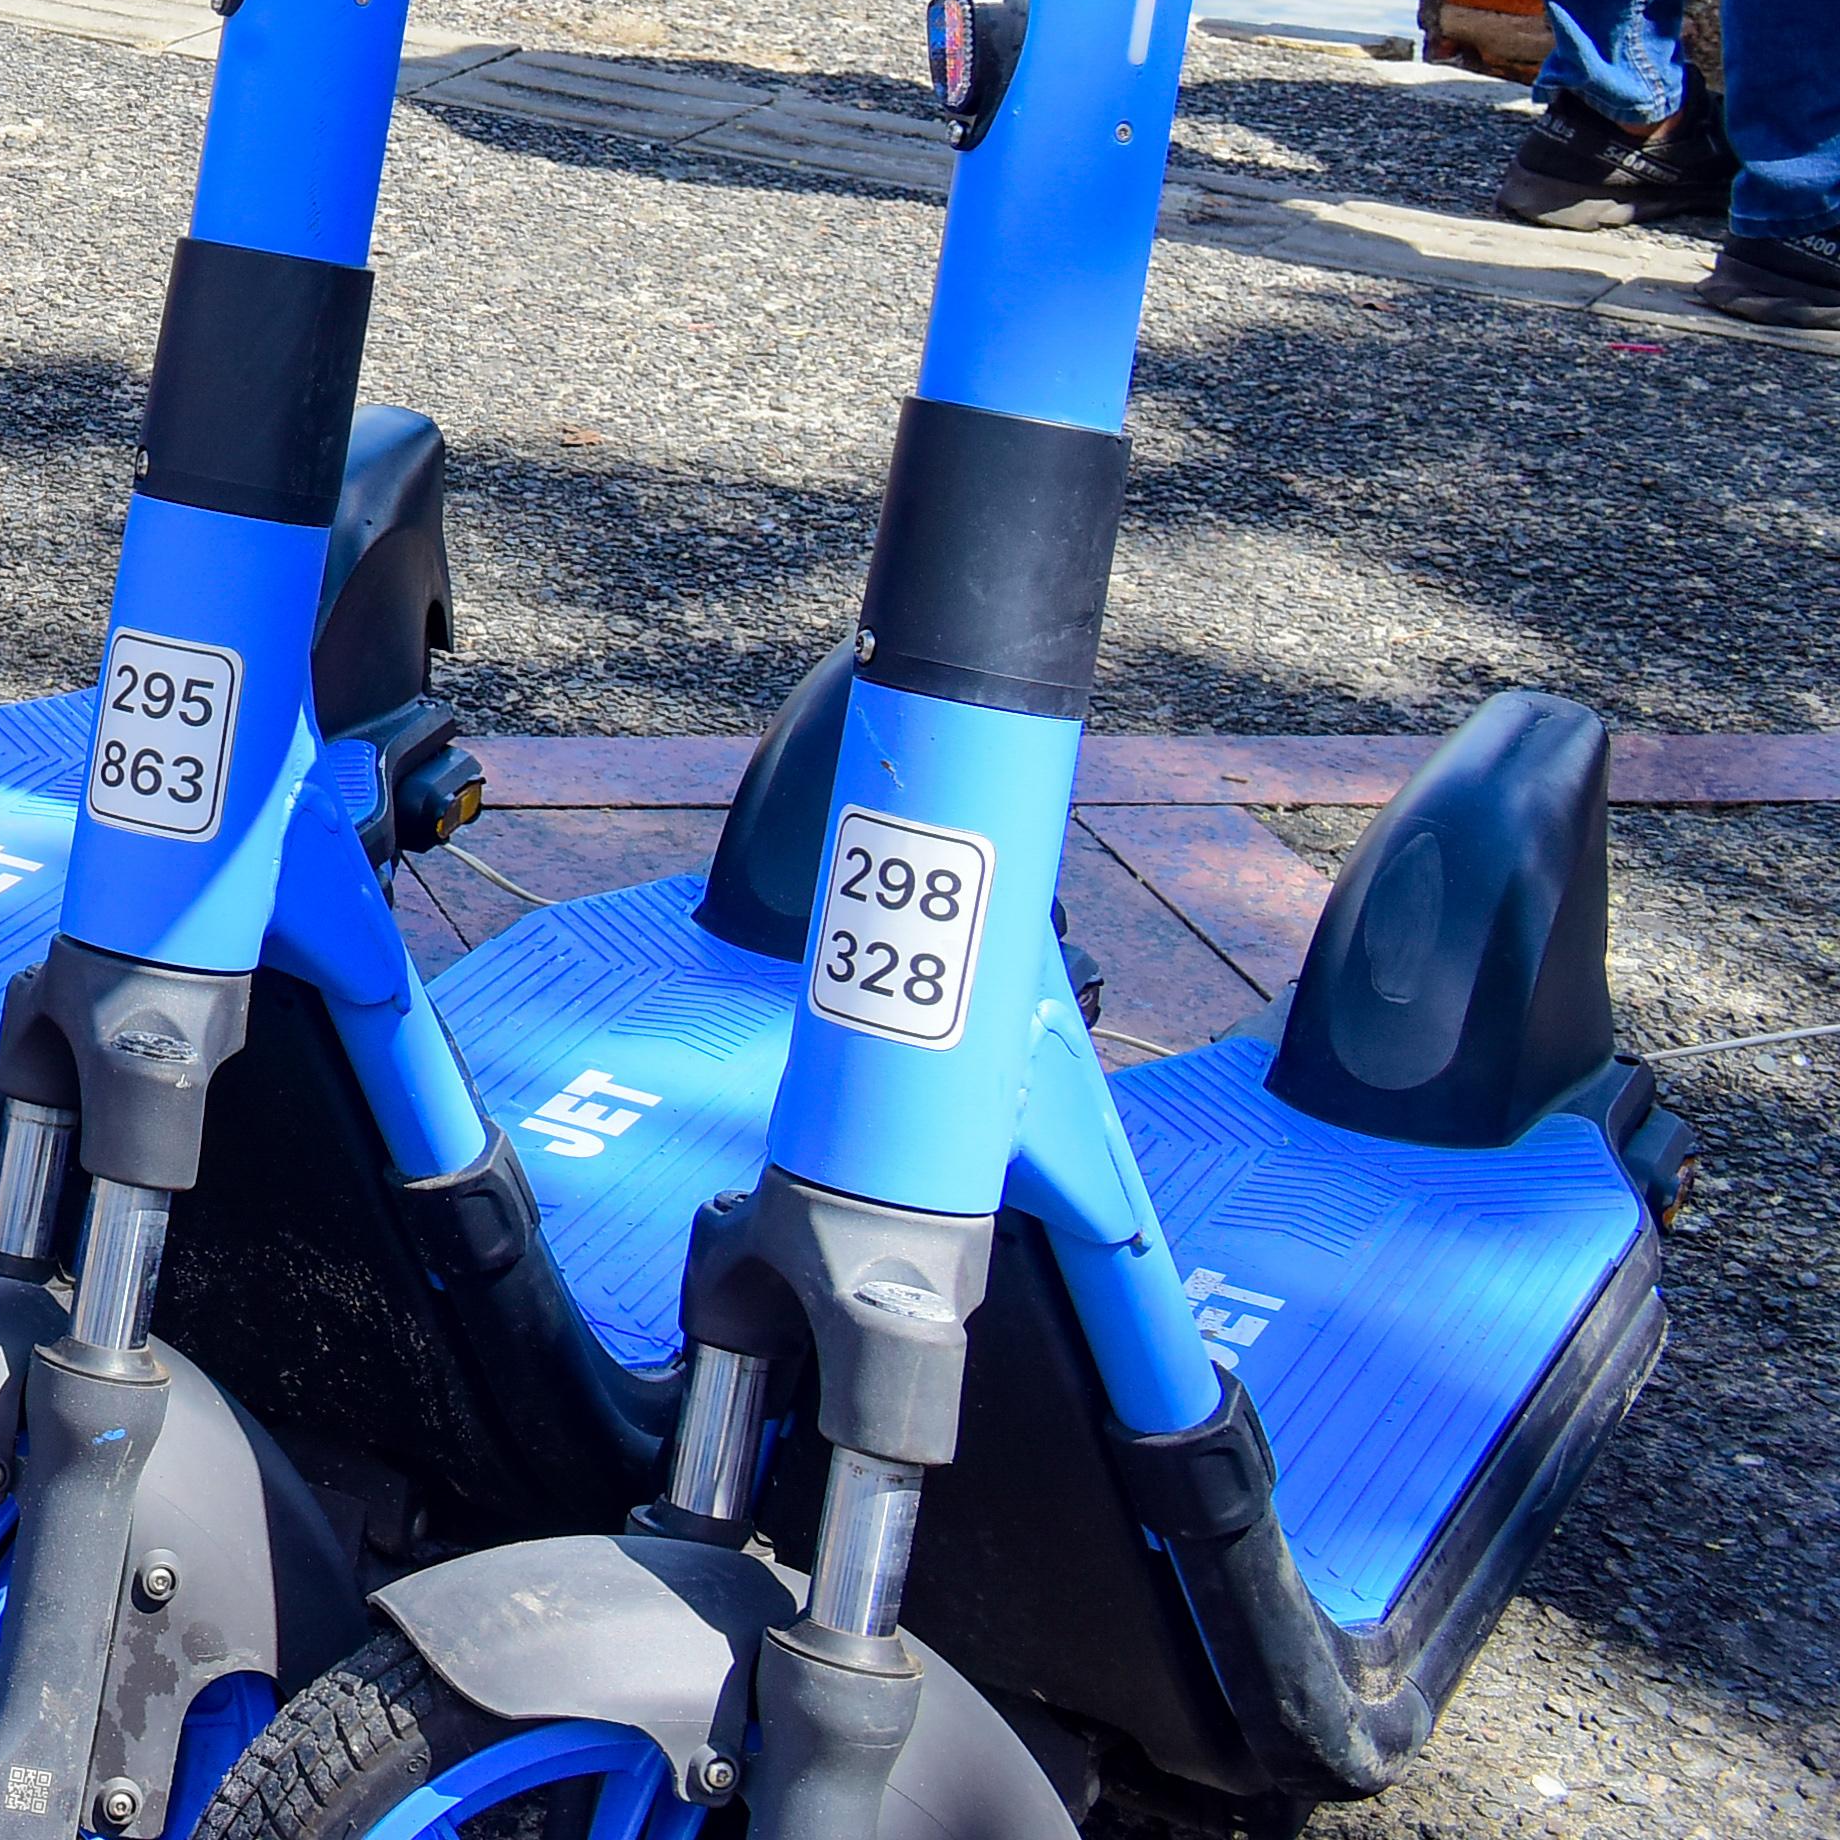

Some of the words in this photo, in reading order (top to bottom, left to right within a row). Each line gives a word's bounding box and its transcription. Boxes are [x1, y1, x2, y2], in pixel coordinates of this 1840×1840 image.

[109, 663, 216, 730] 295
[99, 736, 206, 806] 863
[838, 846, 964, 923] 298
[824, 929, 949, 1008] 328
[519, 1068, 663, 1160] JET
